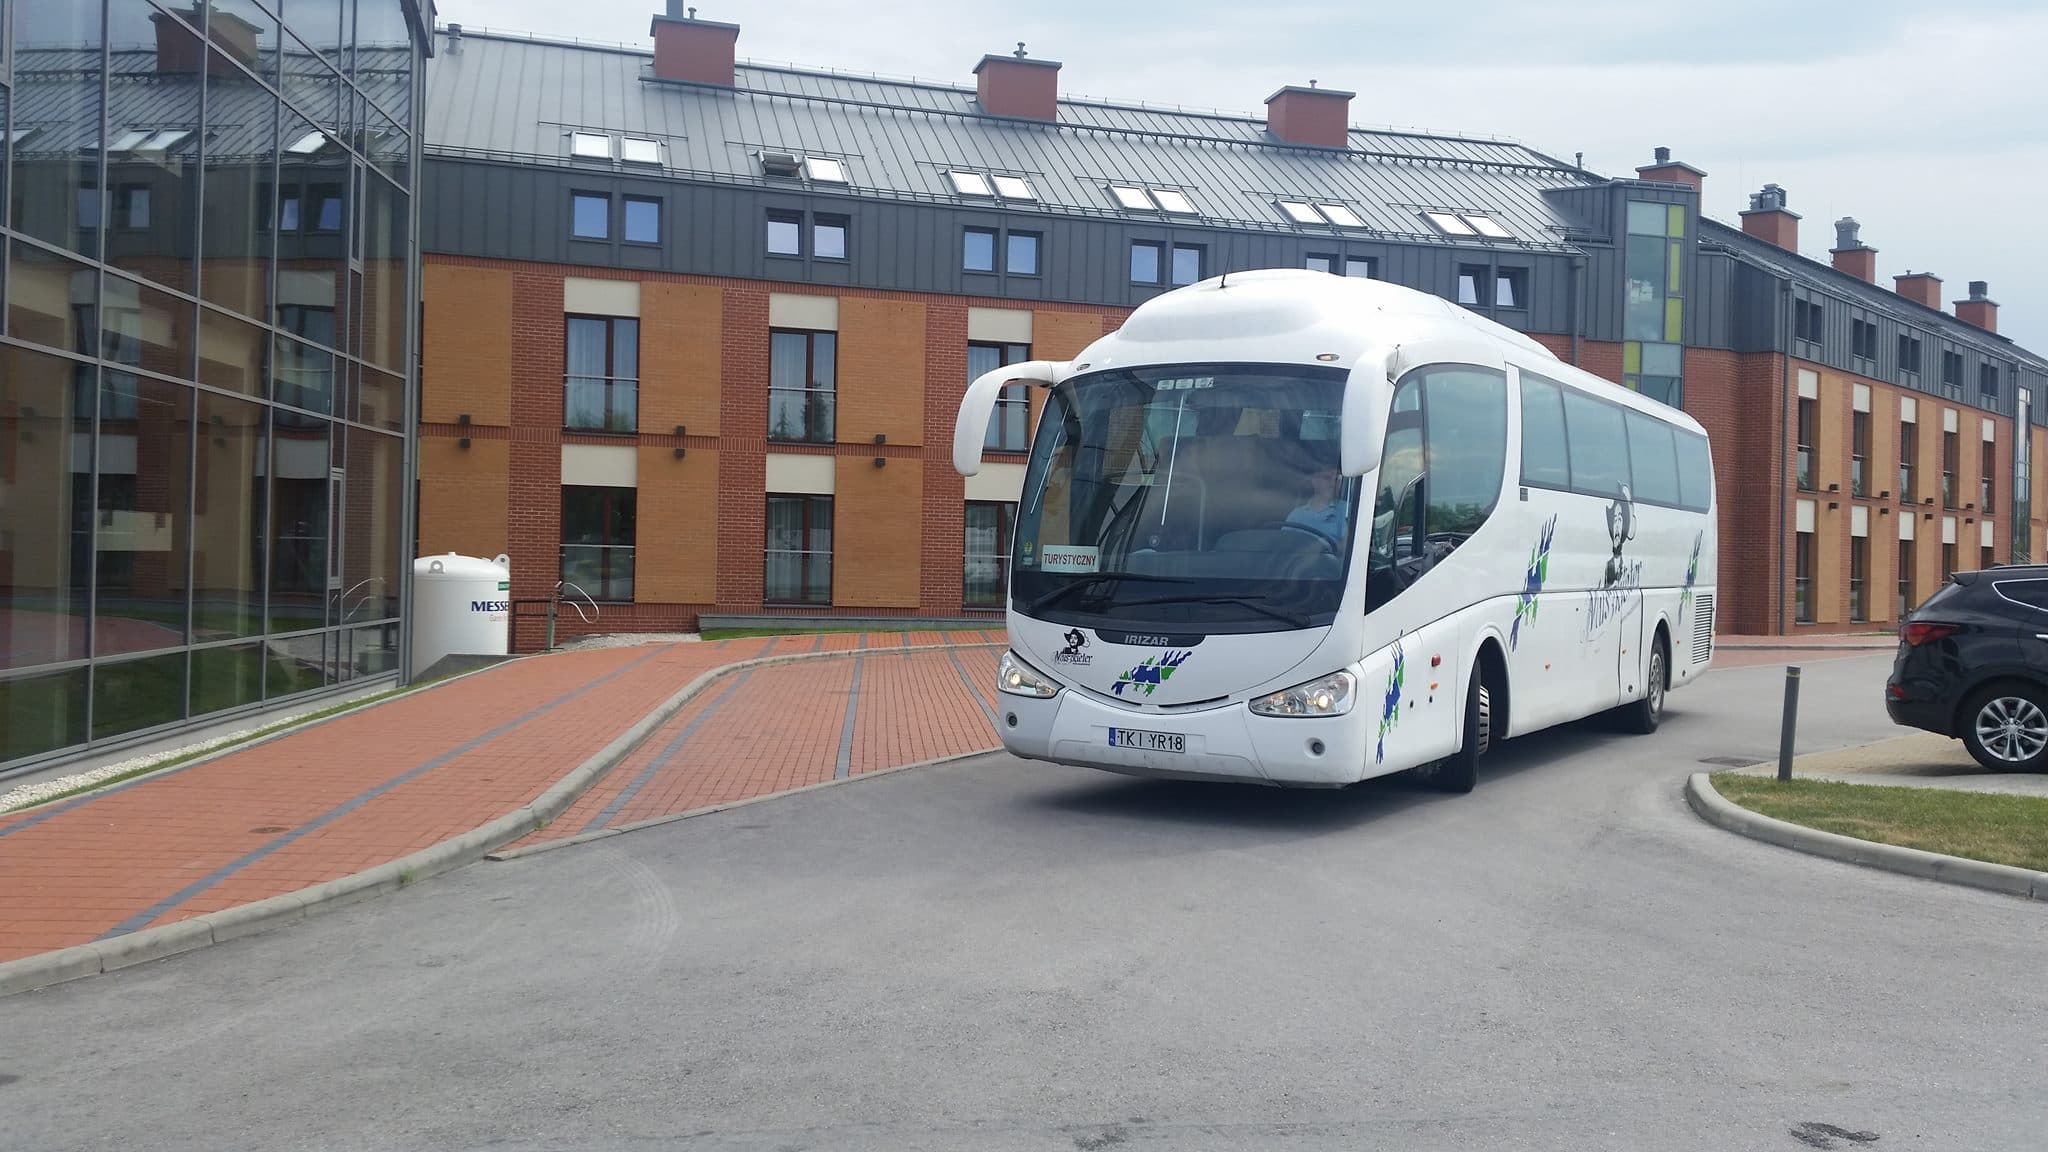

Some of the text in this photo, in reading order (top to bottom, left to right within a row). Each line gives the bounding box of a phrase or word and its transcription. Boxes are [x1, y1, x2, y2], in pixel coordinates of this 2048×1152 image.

[1044, 553, 1096, 566] TURYSTYCZNY
[471, 601, 509, 611] MESSE
[1125, 634, 1169, 646] IRIZAR
[1149, 734, 1183, 750] YR18
